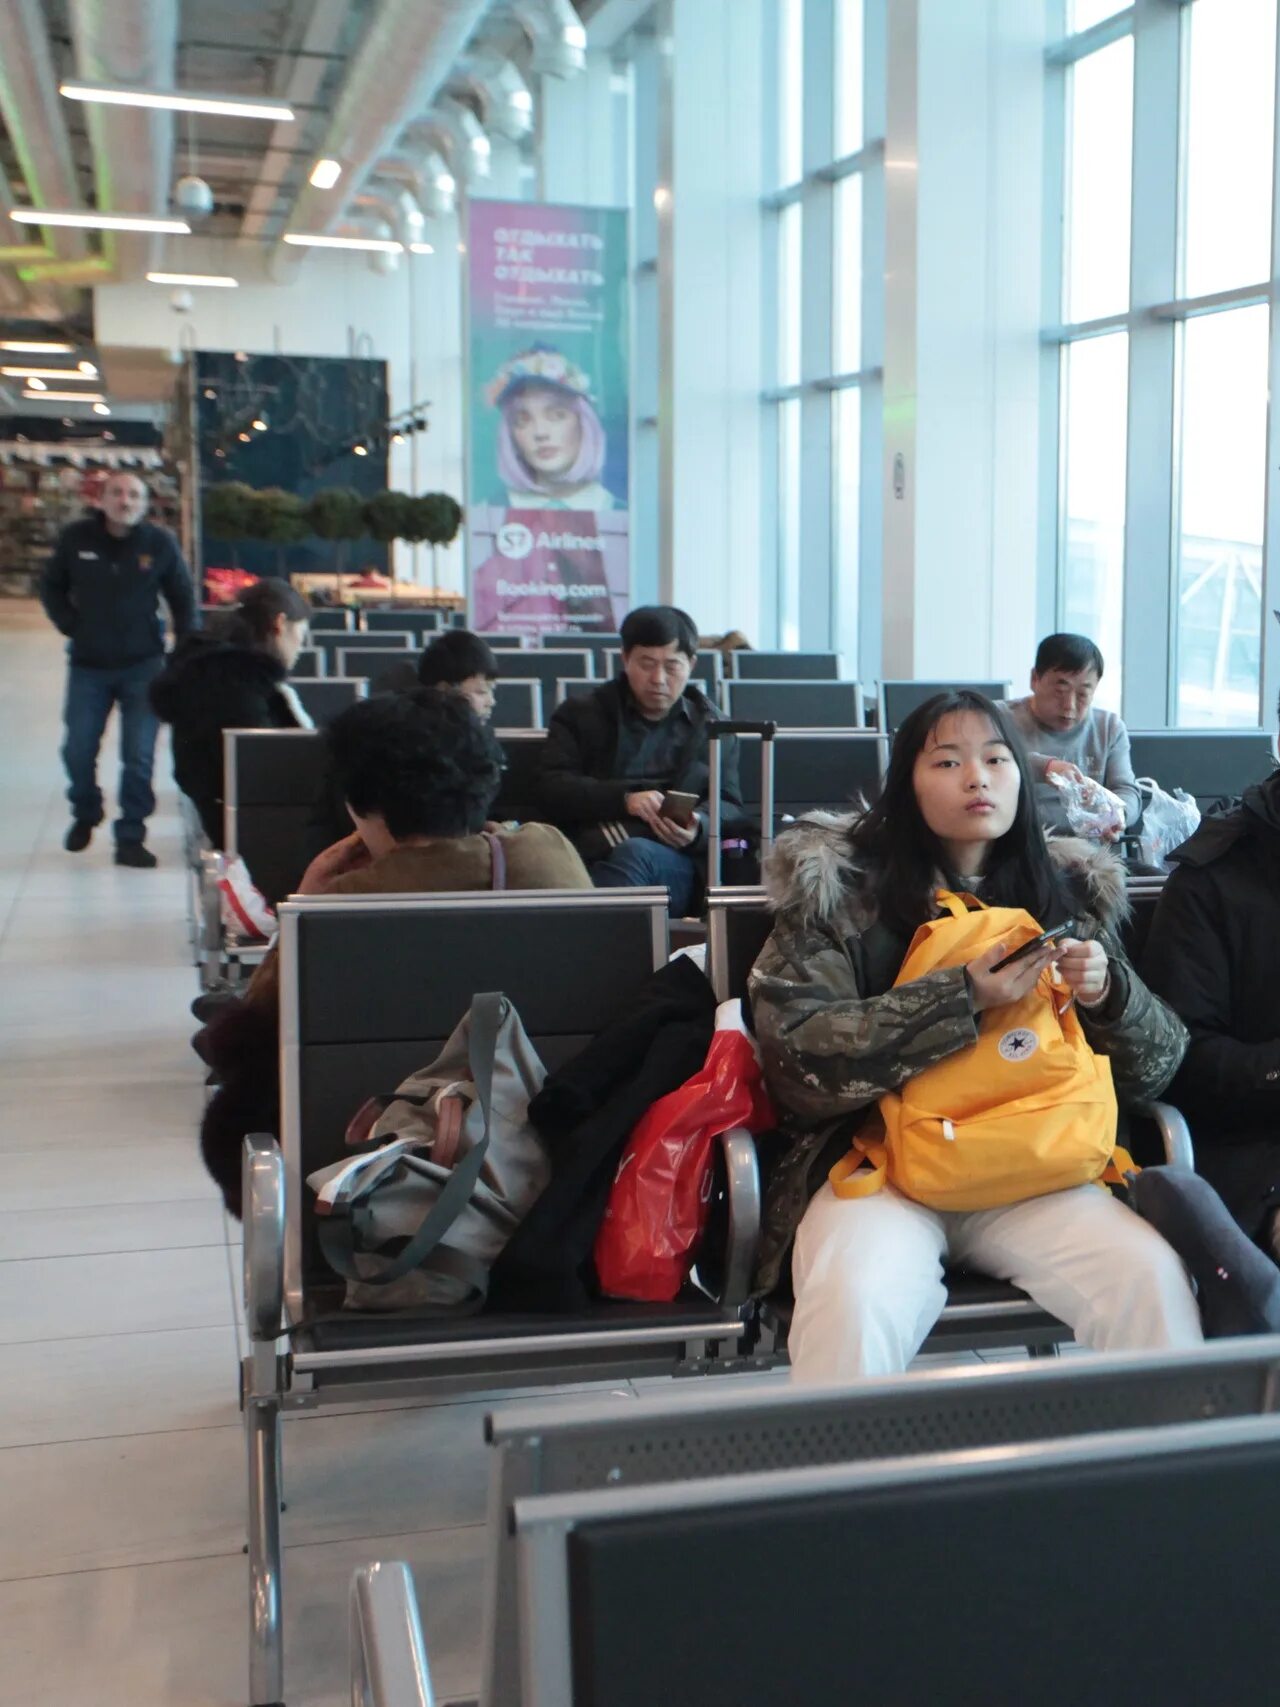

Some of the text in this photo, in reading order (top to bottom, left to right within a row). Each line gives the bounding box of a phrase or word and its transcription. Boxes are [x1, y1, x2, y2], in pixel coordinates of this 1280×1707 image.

[494, 228, 604, 251] ОТДЫХАТЬ
[496, 246, 535, 263] ТАК
[494, 265, 605, 286] ОТДЫХАТЬ
[536, 531, 606, 551] Airlines
[496, 579, 607, 600] Booking.com
